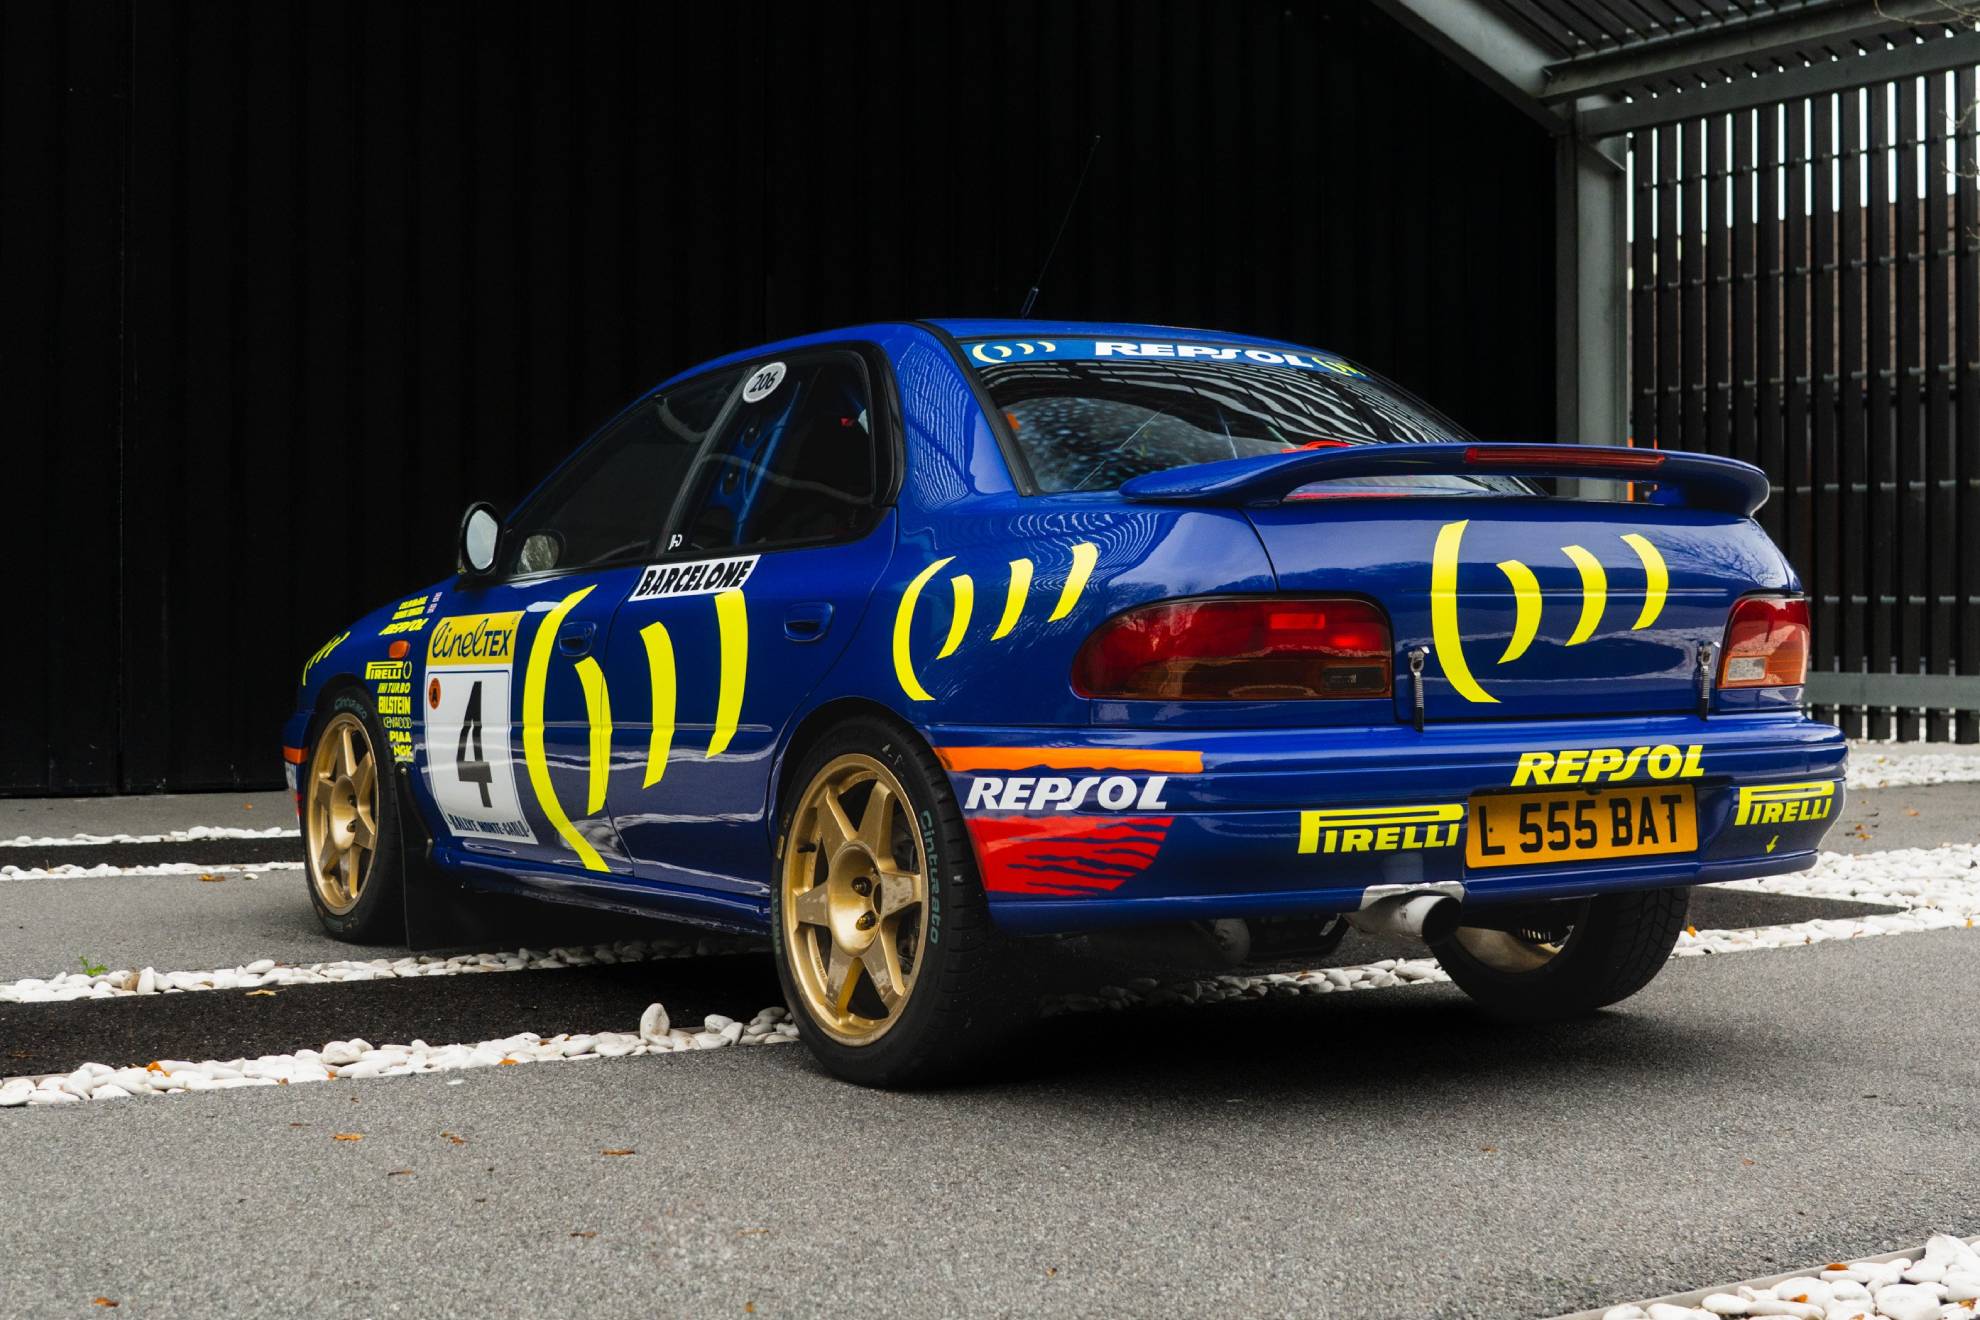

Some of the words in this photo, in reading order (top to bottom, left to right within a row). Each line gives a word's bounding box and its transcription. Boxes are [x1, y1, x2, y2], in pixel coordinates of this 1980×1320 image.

[1095, 341, 1313, 368] REPSOL
[749, 371, 778, 393] 206
[635, 560, 754, 597] BARCELONE
[365, 661, 403, 680] PIRELLI
[378, 696, 411, 714] BILSTEIN
[389, 731, 412, 743] PIAA
[393, 744, 412, 757] NGK
[456, 681, 492, 808] 4
[1511, 744, 1705, 786] REPSOL
[964, 776, 1168, 811] REPSOL
[1734, 781, 1835, 826] PIRELLI
[1297, 803, 1464, 854] PIRELLI
[1478, 806, 1505, 856] L
[1519, 800, 1598, 853] 555
[1609, 795, 1682, 847] BAT
[920, 810, 941, 944] Cinturato
